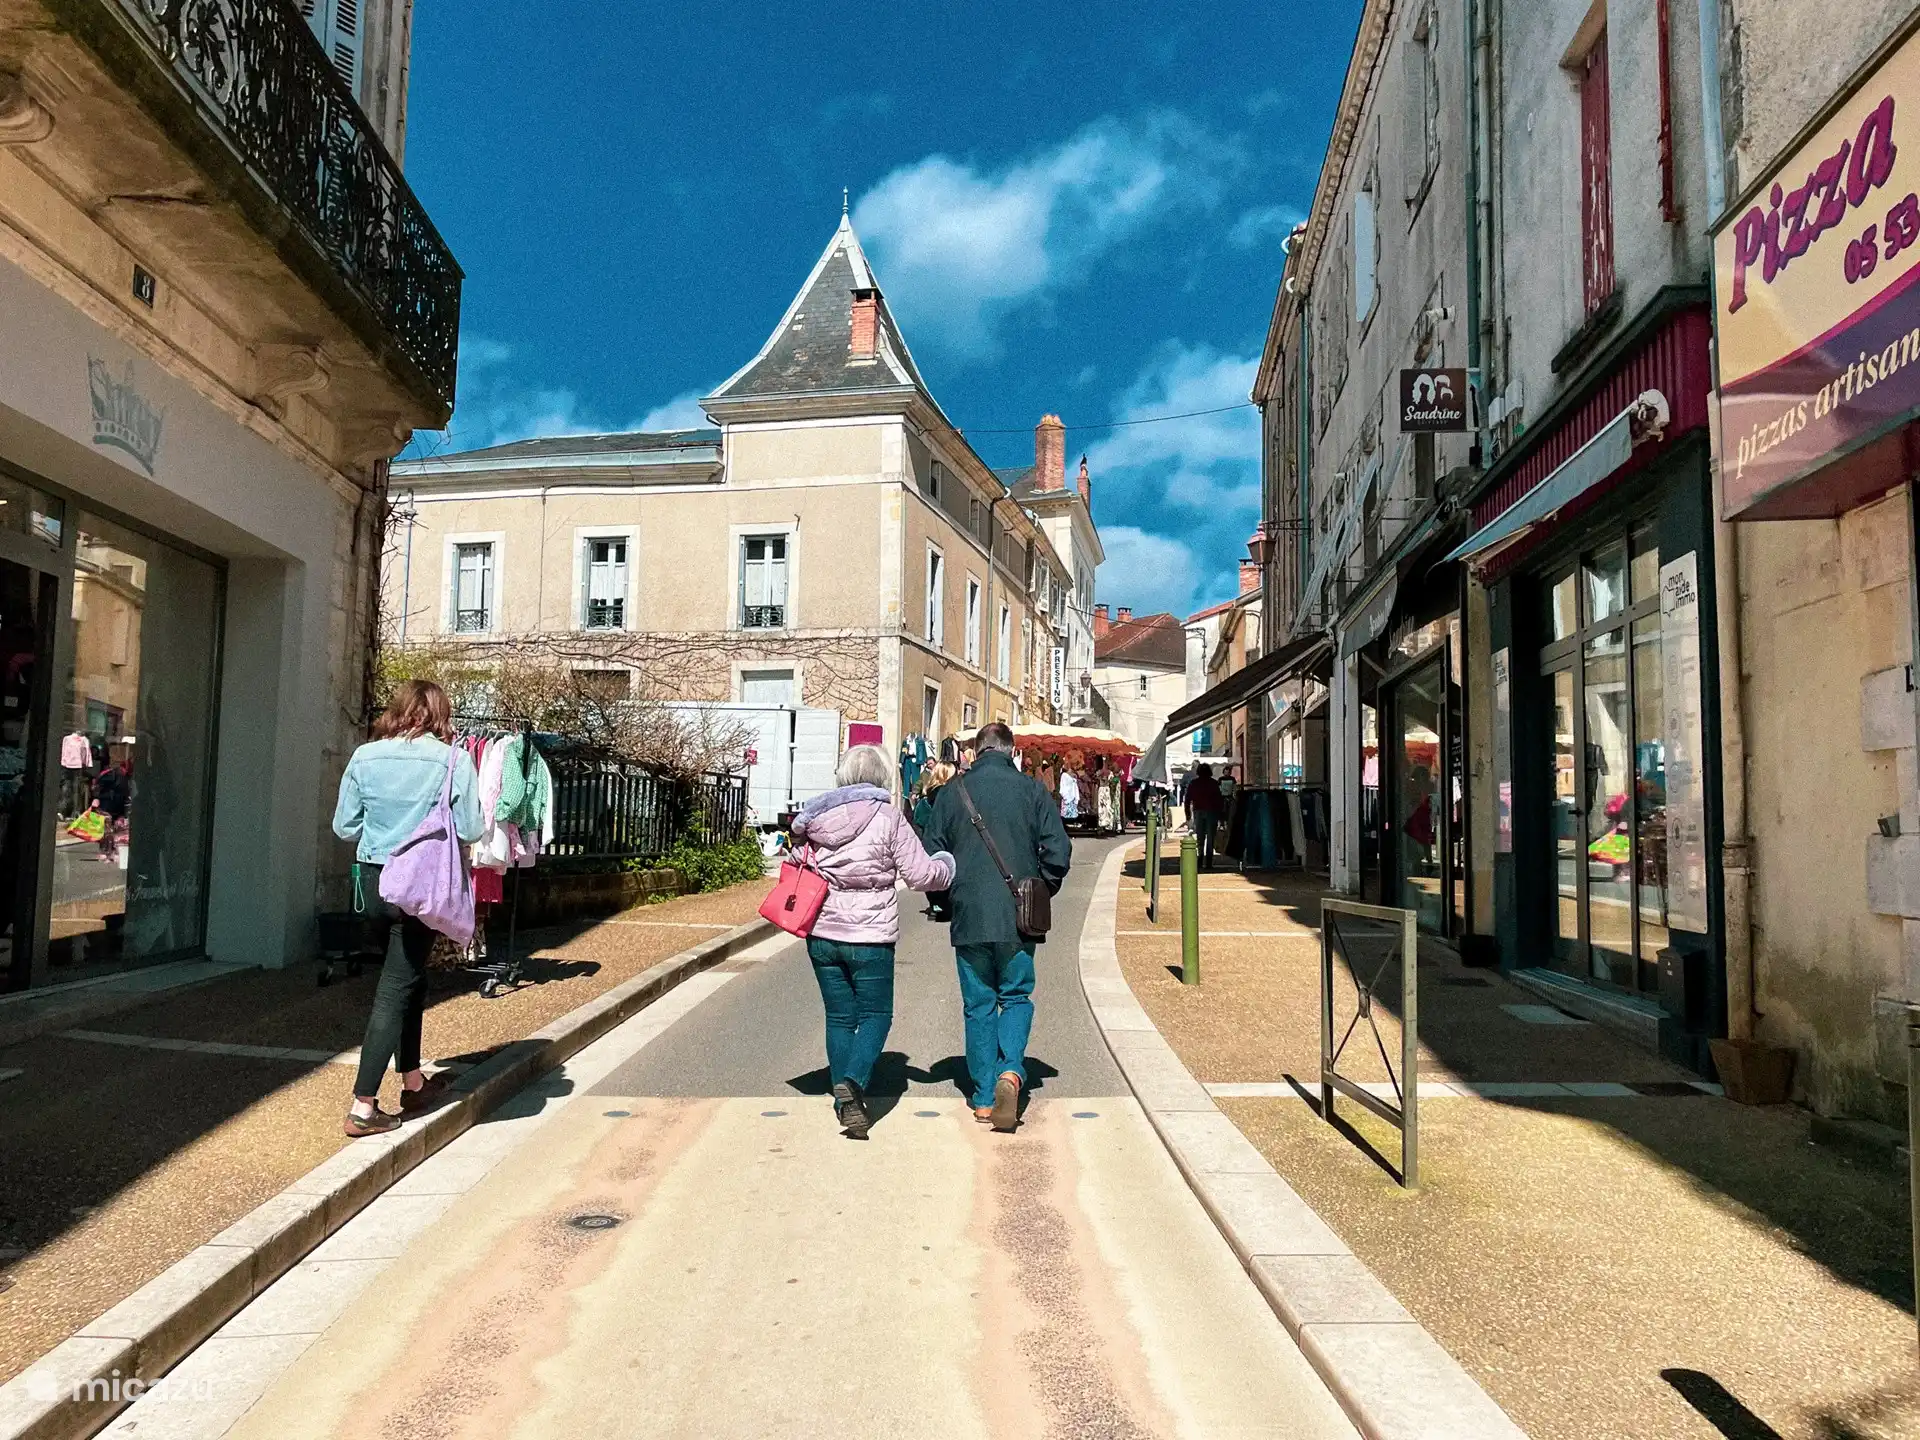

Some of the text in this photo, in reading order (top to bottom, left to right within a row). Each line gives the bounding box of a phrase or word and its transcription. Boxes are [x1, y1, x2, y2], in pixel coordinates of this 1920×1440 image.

[1844, 192, 1920, 284] 05 53
[141, 275, 151, 300] 8
[1736, 327, 1920, 480] pizzas artisan
[1404, 405, 1462, 421] Sandrine
[1668, 571, 1683, 588] mon
[1675, 580, 1690, 597] aide
[1675, 592, 1696, 609] immo
